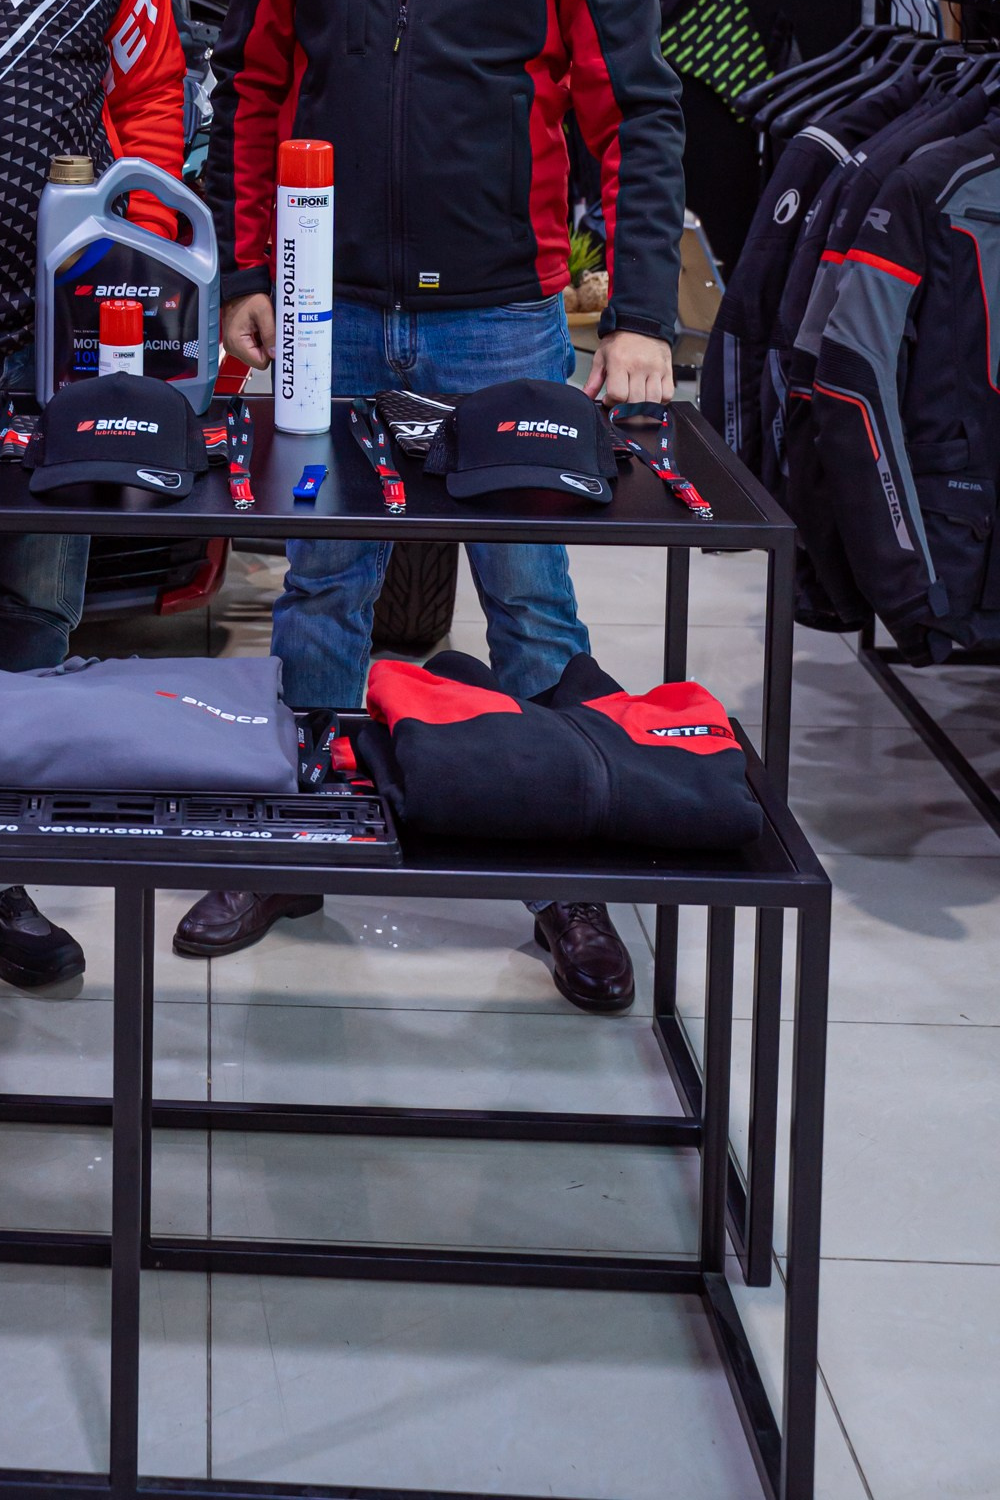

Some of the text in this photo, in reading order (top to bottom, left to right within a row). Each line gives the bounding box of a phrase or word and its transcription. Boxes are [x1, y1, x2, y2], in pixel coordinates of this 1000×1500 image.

[297, 197, 328, 206] IPONE
[299, 215, 320, 225] Care
[95, 282, 161, 297] ardeca
[282, 237, 296, 400] CLEANER POLISH
[301, 314, 319, 322] BIKE
[73, 338, 181, 351] MOT ACING
[95, 416, 159, 434] ardeca
[517, 419, 579, 439] ardeca
[516, 430, 559, 440] lubricants
[947, 480, 983, 492] RICHA
[881, 471, 902, 530] RICHA
[181, 696, 269, 724] ardeca
[37, 824, 164, 836] veterr.com
[180, 829, 273, 839] 702-40-40
